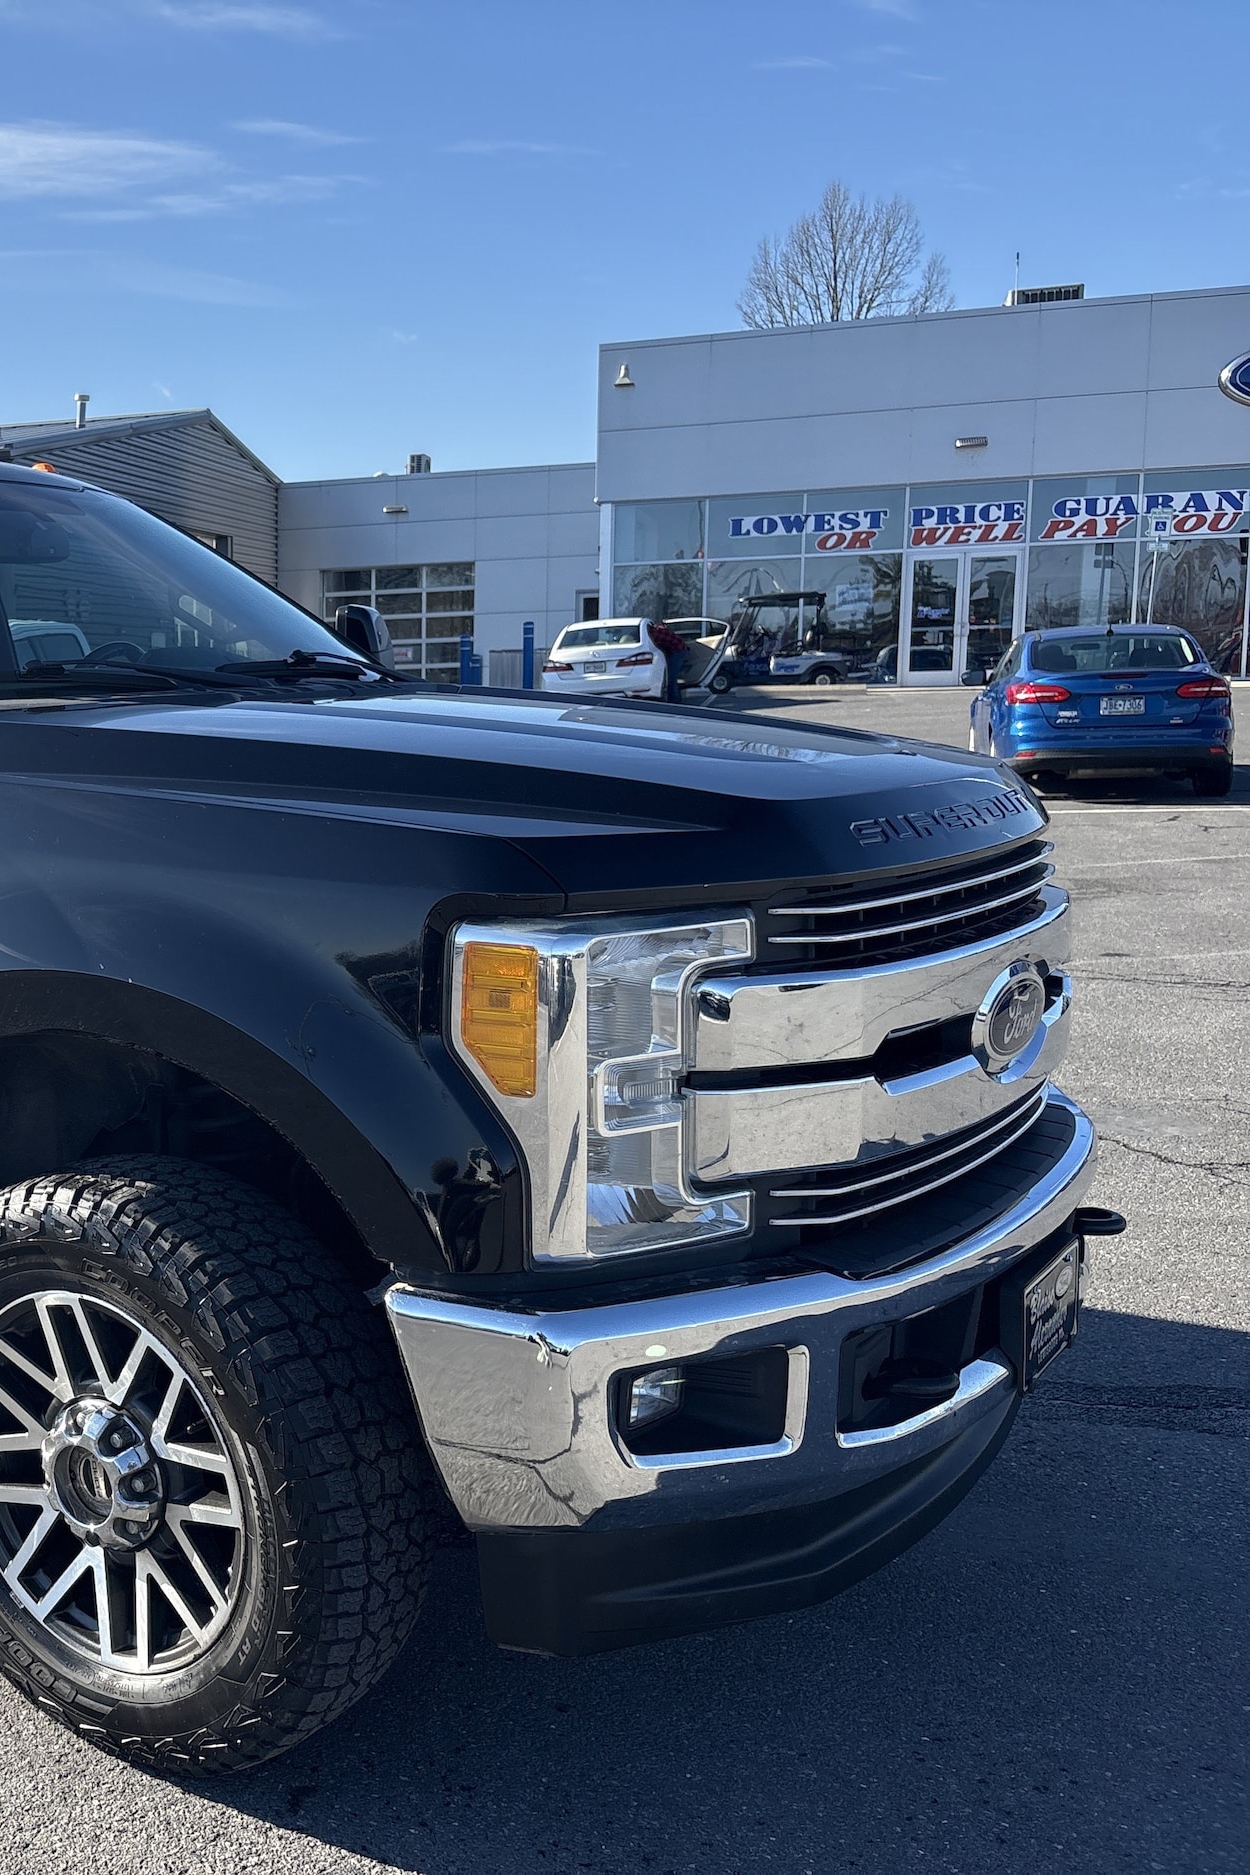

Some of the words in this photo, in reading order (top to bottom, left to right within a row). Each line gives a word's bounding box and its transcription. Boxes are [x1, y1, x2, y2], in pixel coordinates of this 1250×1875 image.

[730, 510, 887, 536] LOWEST
[911, 502, 1024, 527] PRICE
[817, 531, 877, 550] OR
[911, 522, 1023, 546] WE'LL
[1040, 516, 1135, 539] PAY
[1170, 512, 1242, 534] OU
[1003, 983, 1039, 1045] Ford
[81, 1257, 226, 1398] COOPER
[237, 1640, 252, 1667] AT
